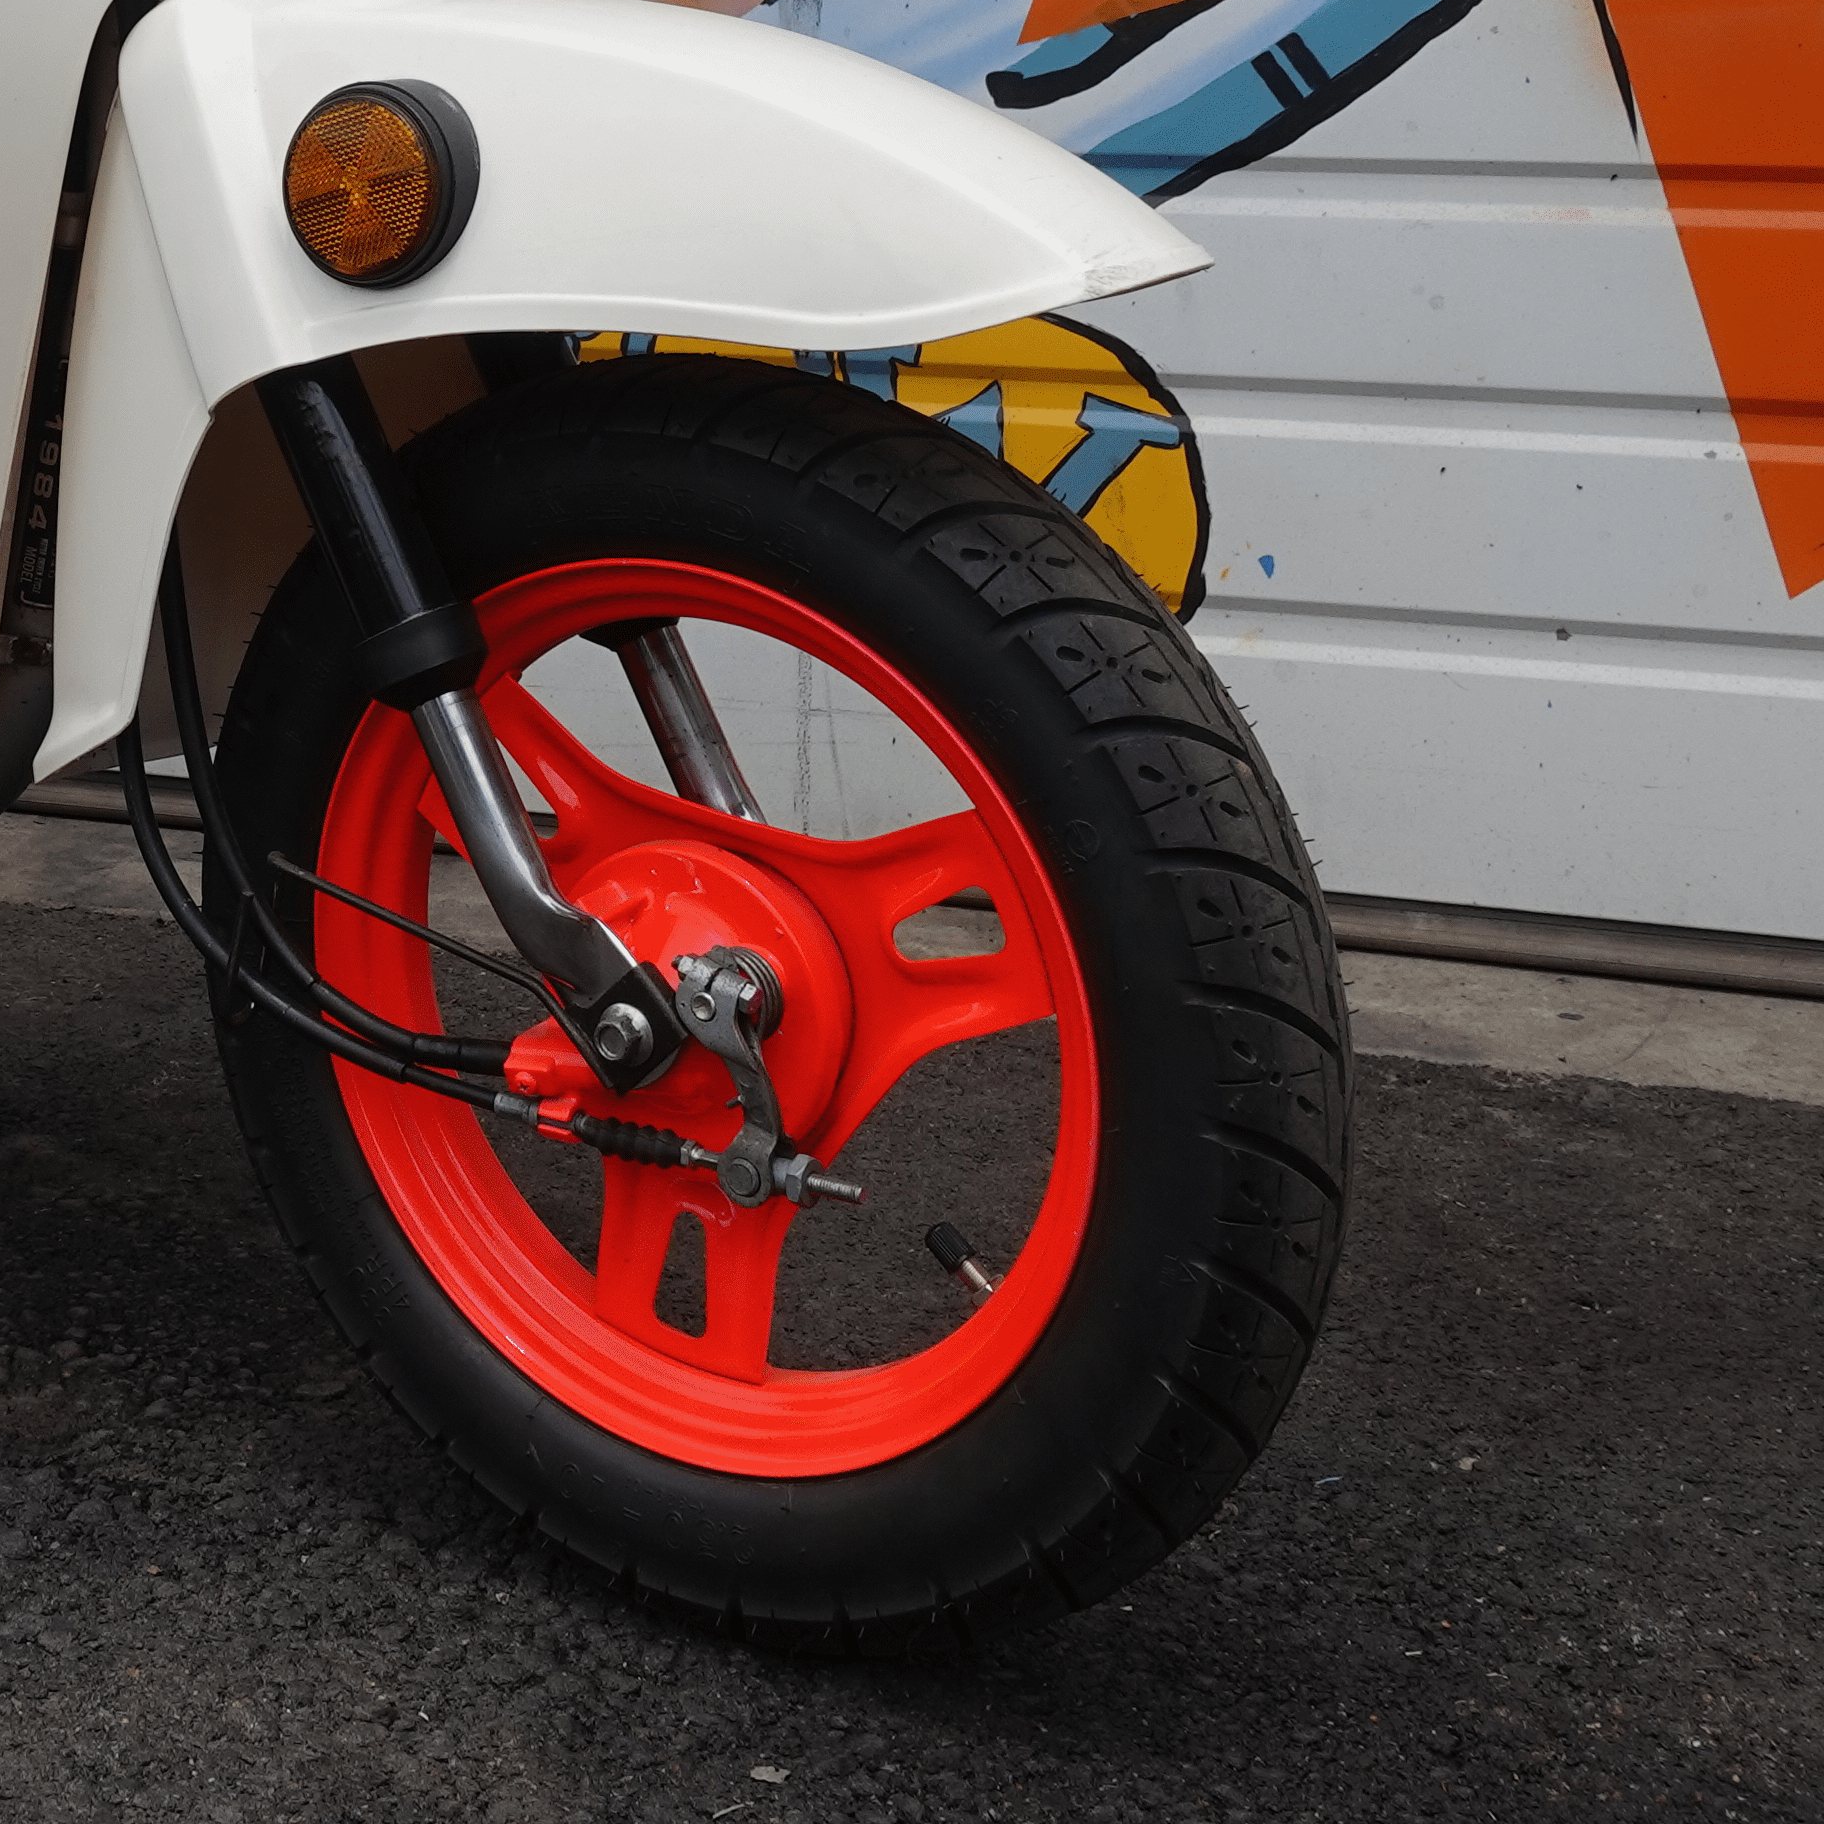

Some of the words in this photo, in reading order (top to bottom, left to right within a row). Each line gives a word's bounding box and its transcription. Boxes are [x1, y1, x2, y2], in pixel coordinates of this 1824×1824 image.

[28, 413, 63, 531] 1984
[20, 545, 38, 583] MODEL
[525, 481, 814, 574] KENDA
